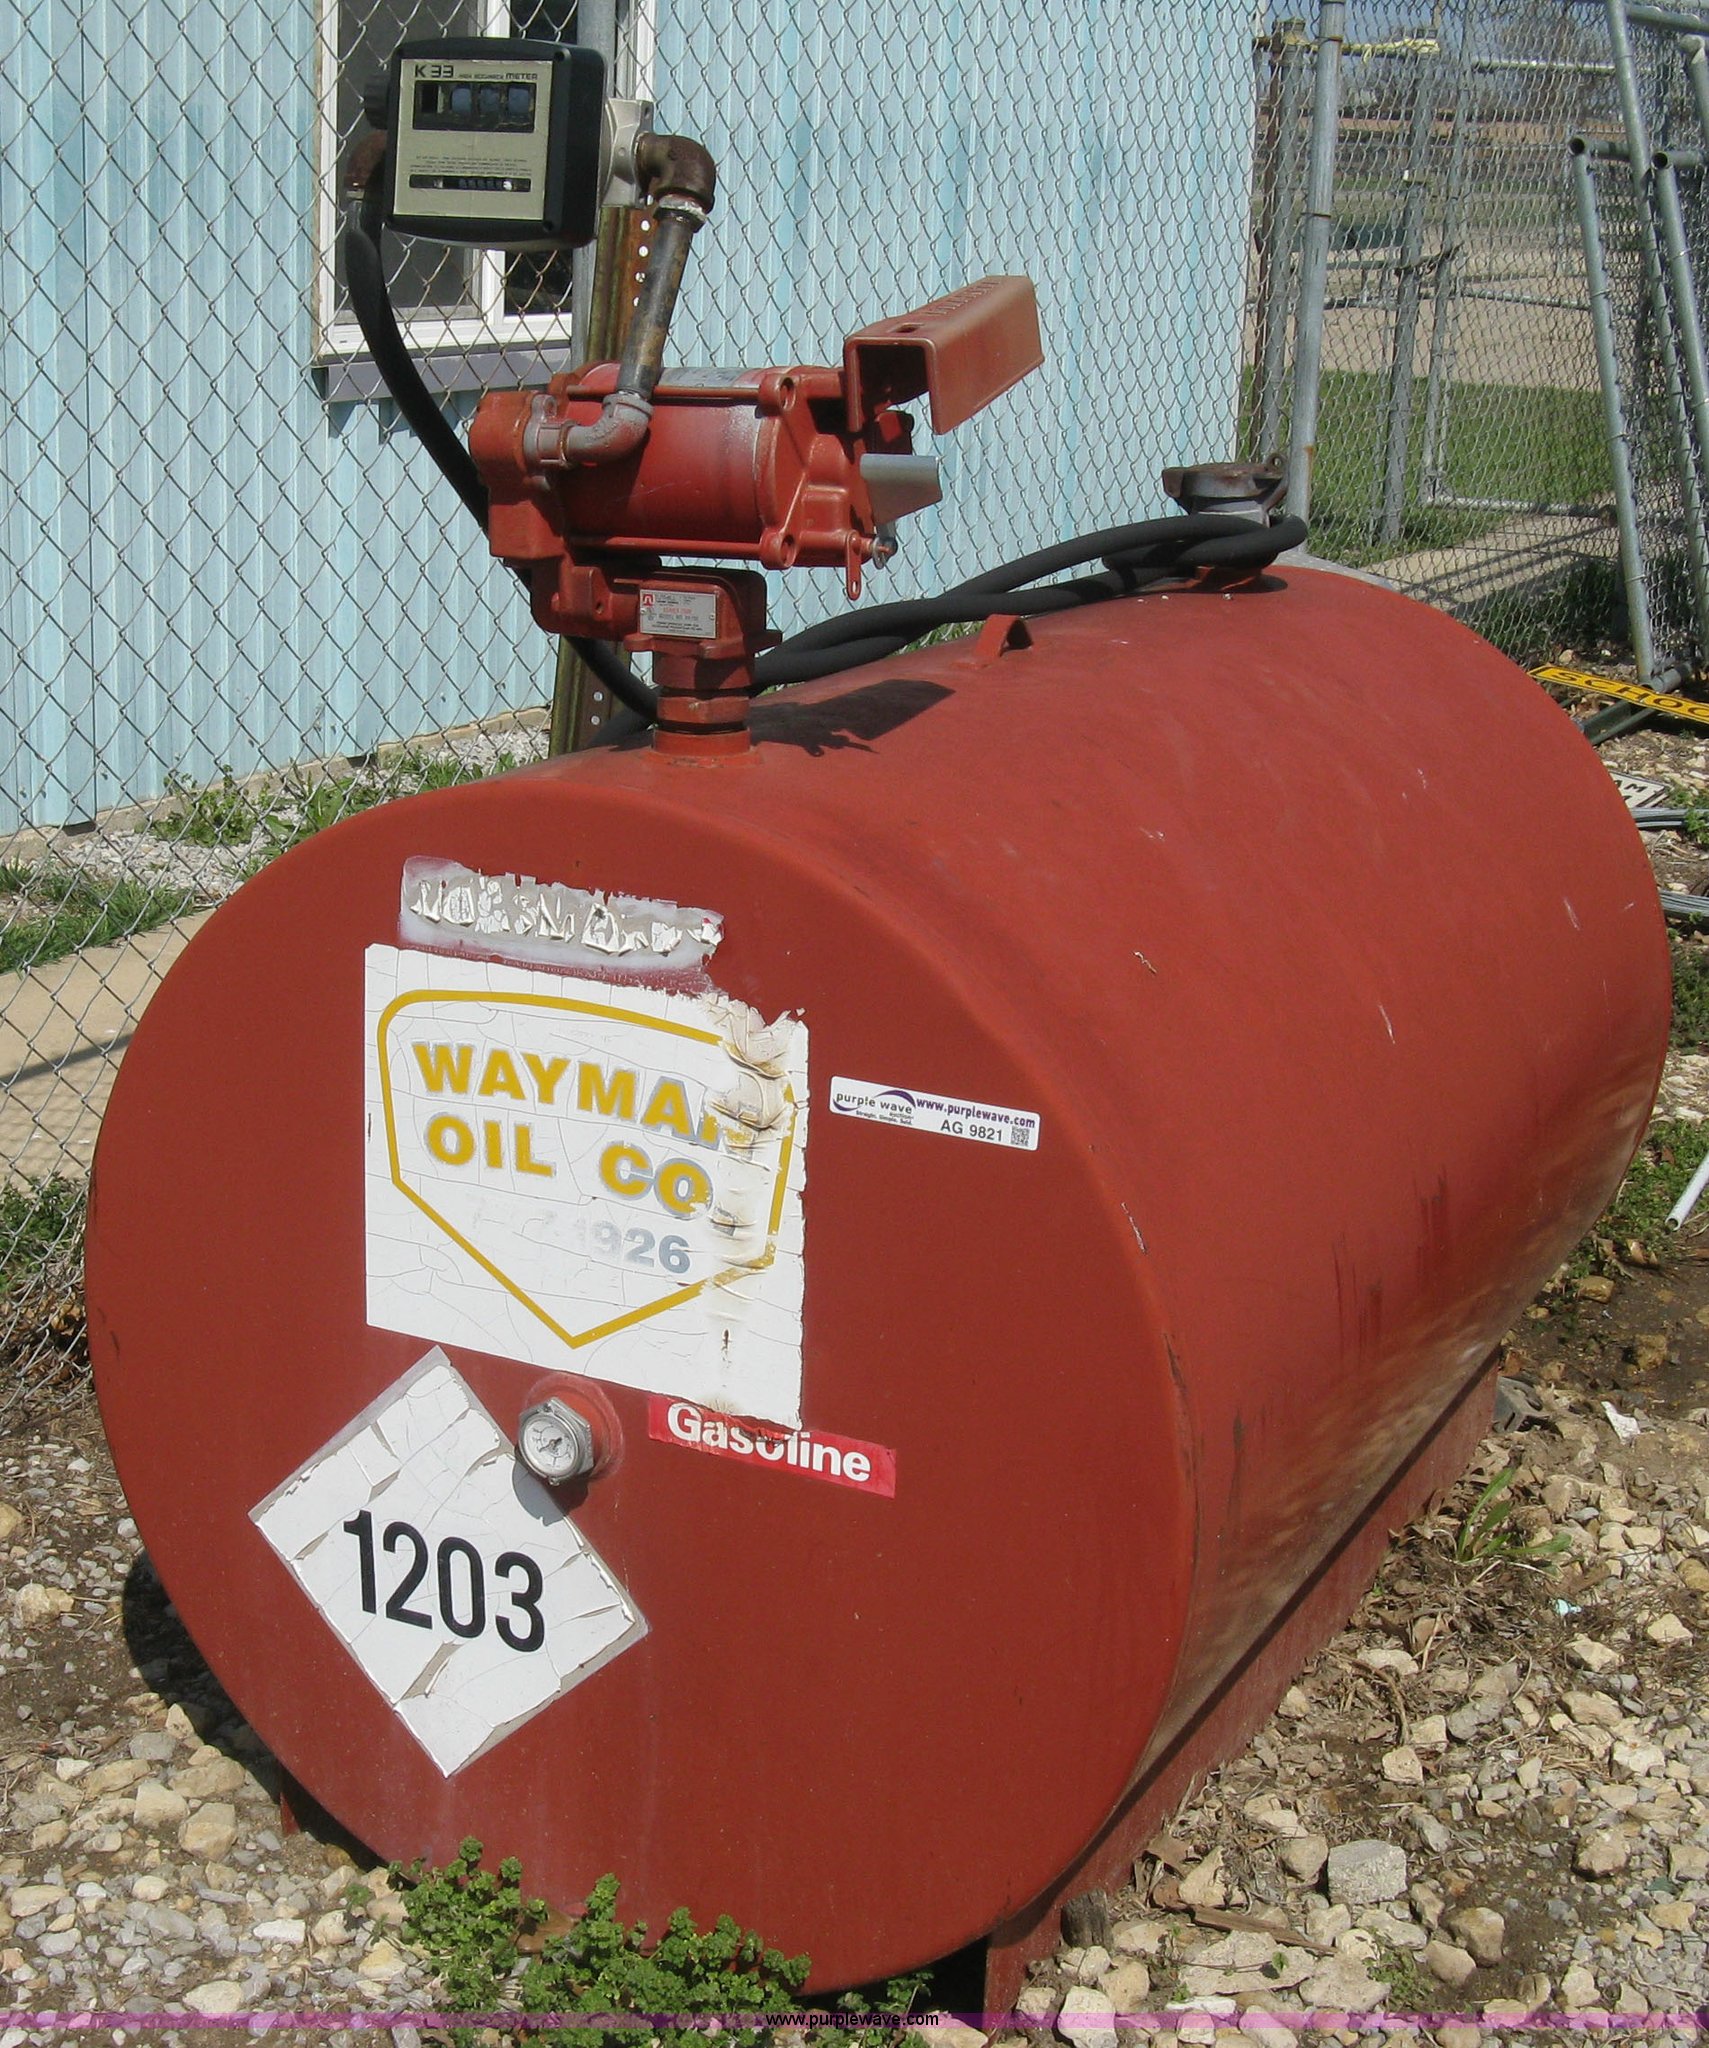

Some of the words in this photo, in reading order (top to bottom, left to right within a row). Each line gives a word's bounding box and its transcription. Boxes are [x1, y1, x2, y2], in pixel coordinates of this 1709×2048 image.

[414, 65, 427, 78] K
[431, 65, 454, 79] 33
[505, 72, 538, 80] METER
[836, 1091, 876, 1109] purple
[880, 1101, 913, 1115] wave
[916, 1097, 1036, 1128] www.purplewave.com
[940, 1119, 963, 1135] AG
[969, 1124, 1003, 1142] 9821
[425, 1111, 556, 1177] OIL
[599, 1140, 714, 1220] CO
[574, 1217, 692, 1274] 926
[667, 1402, 871, 1482] Gasoline
[343, 1509, 545, 1653] 1203
